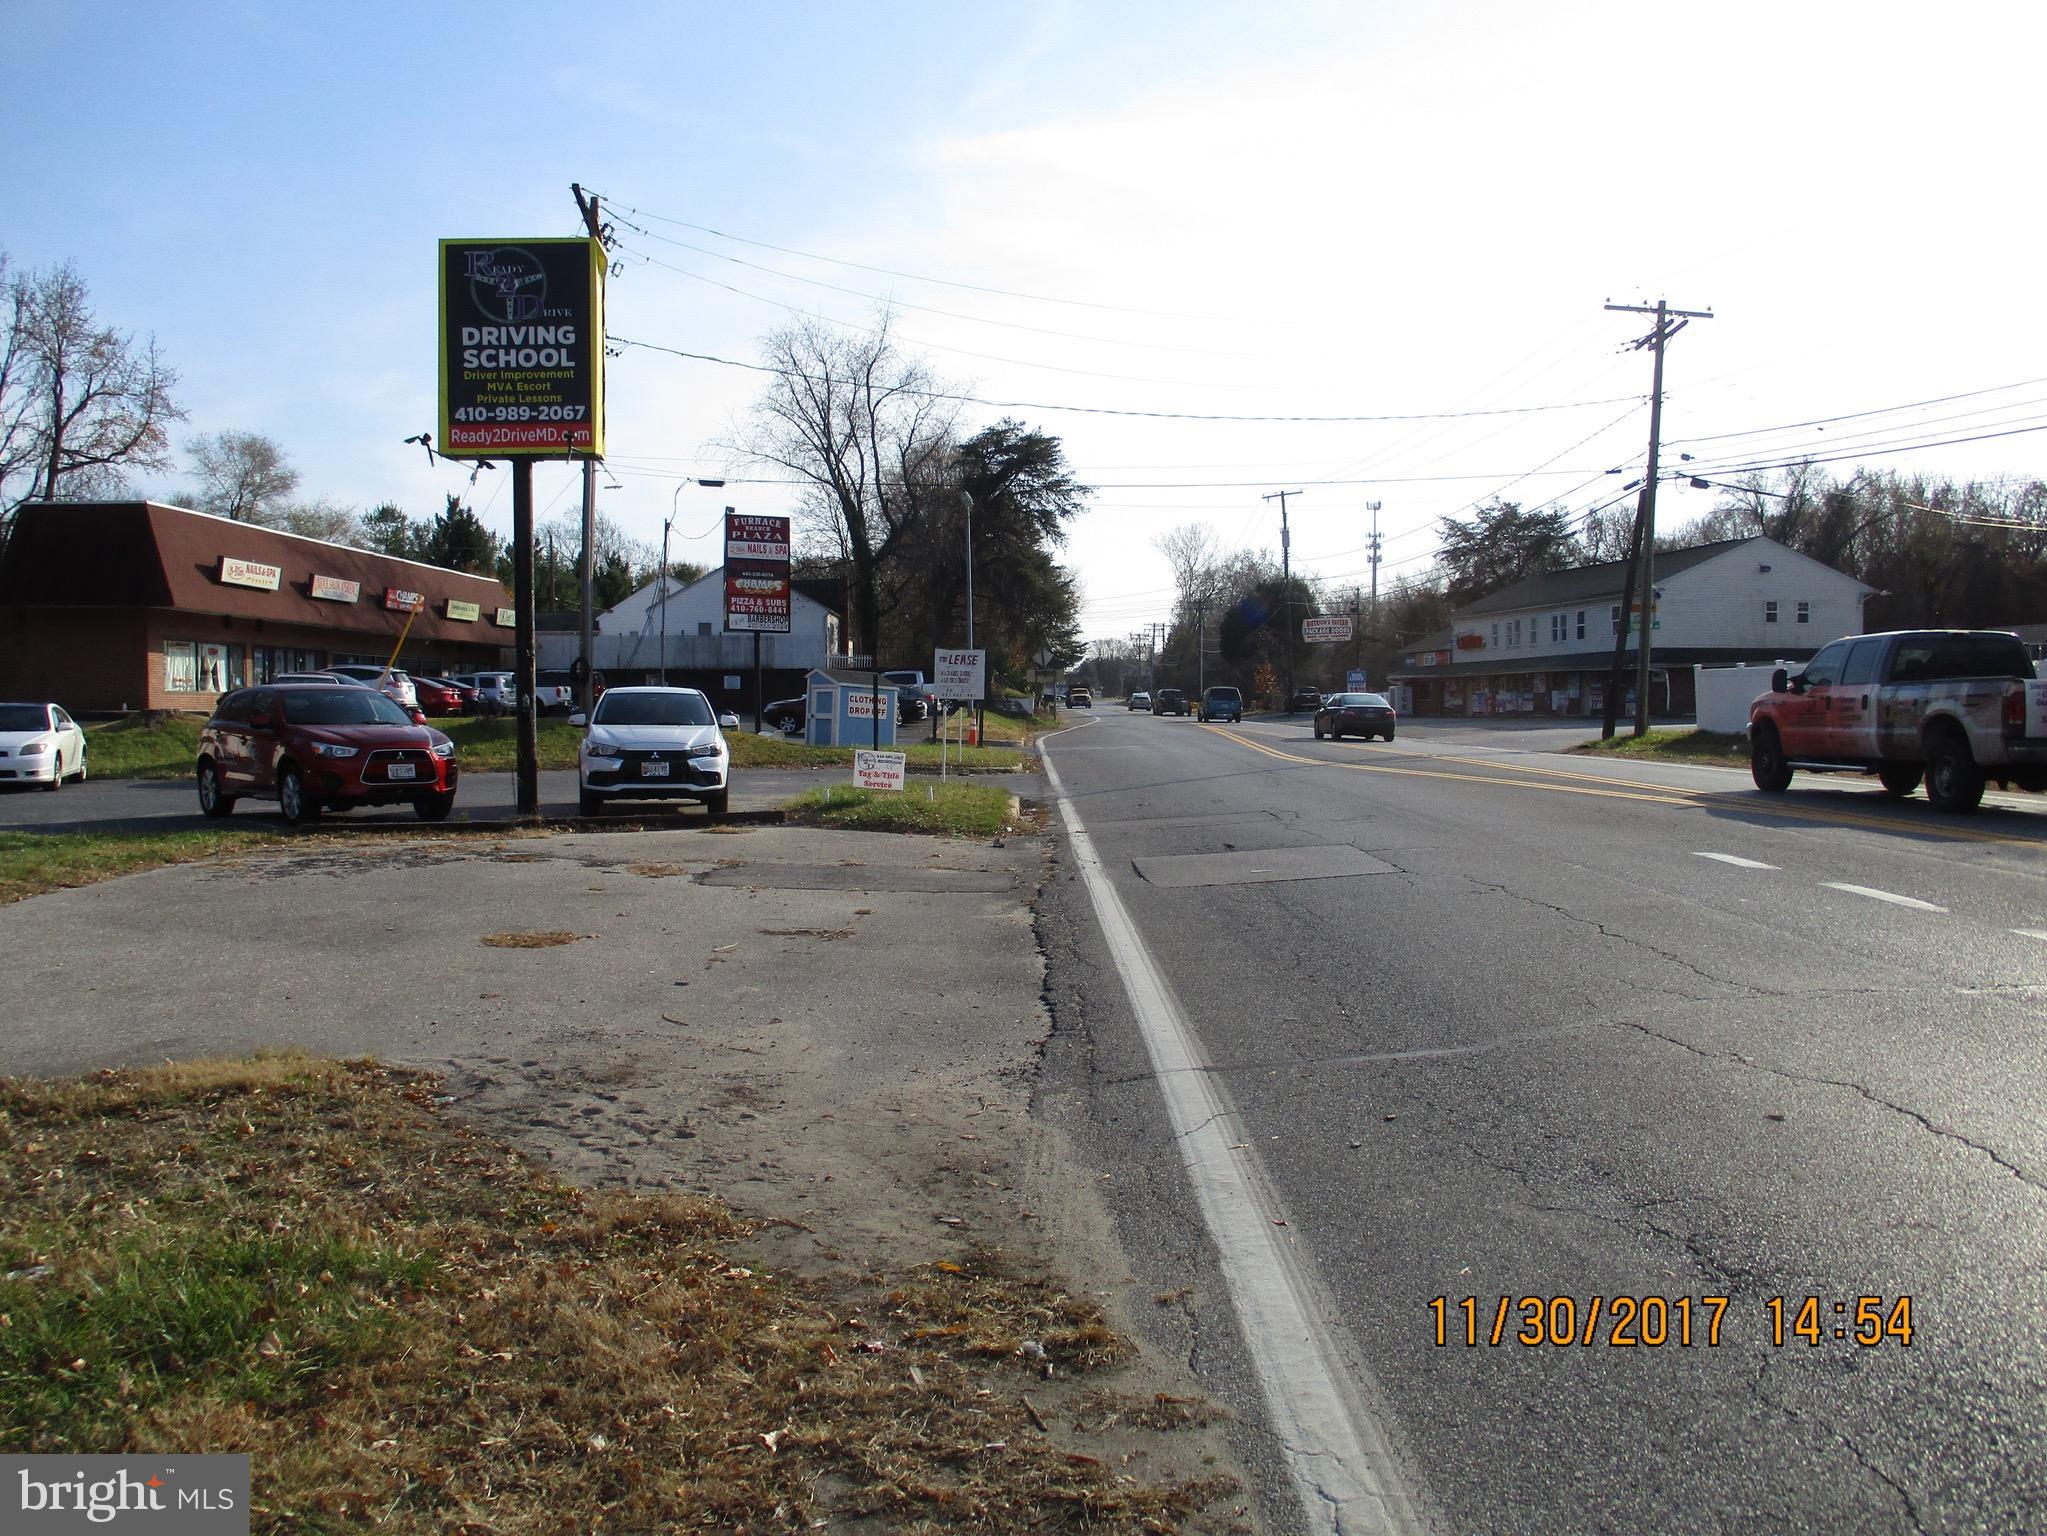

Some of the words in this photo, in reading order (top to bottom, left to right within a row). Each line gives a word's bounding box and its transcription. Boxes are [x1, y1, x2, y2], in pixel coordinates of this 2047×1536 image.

[462, 326, 576, 346] DRIVING
[463, 348, 576, 368] SCHOOL
[464, 371, 497, 380] Driver
[501, 370, 575, 380] Improvement
[487, 382, 513, 391] MVA
[517, 382, 551, 391] Escort
[477, 394, 515, 404] Private
[519, 394, 562, 403] Lessons
[454, 405, 586, 421] 410-989-2067
[451, 427, 590, 444] Ready2DriveMD.cm
[734, 517, 781, 528] FURNACE
[732, 531, 782, 541] PLAZA
[747, 544, 767, 554] NAILS
[775, 545, 787, 556] SPA
[731, 597, 754, 605] PIZZA
[757, 598, 763, 606] &
[766, 598, 787, 607] SUBS
[747, 614, 789, 625] BARBERSHOP
[1305, 627, 1331, 635] PACKAGE
[949, 654, 978, 665] LEASE
[849, 695, 886, 705] CLOTHNG
[858, 770, 872, 779] Tag
[882, 771, 900, 780] Title
[864, 780, 892, 789] Service
